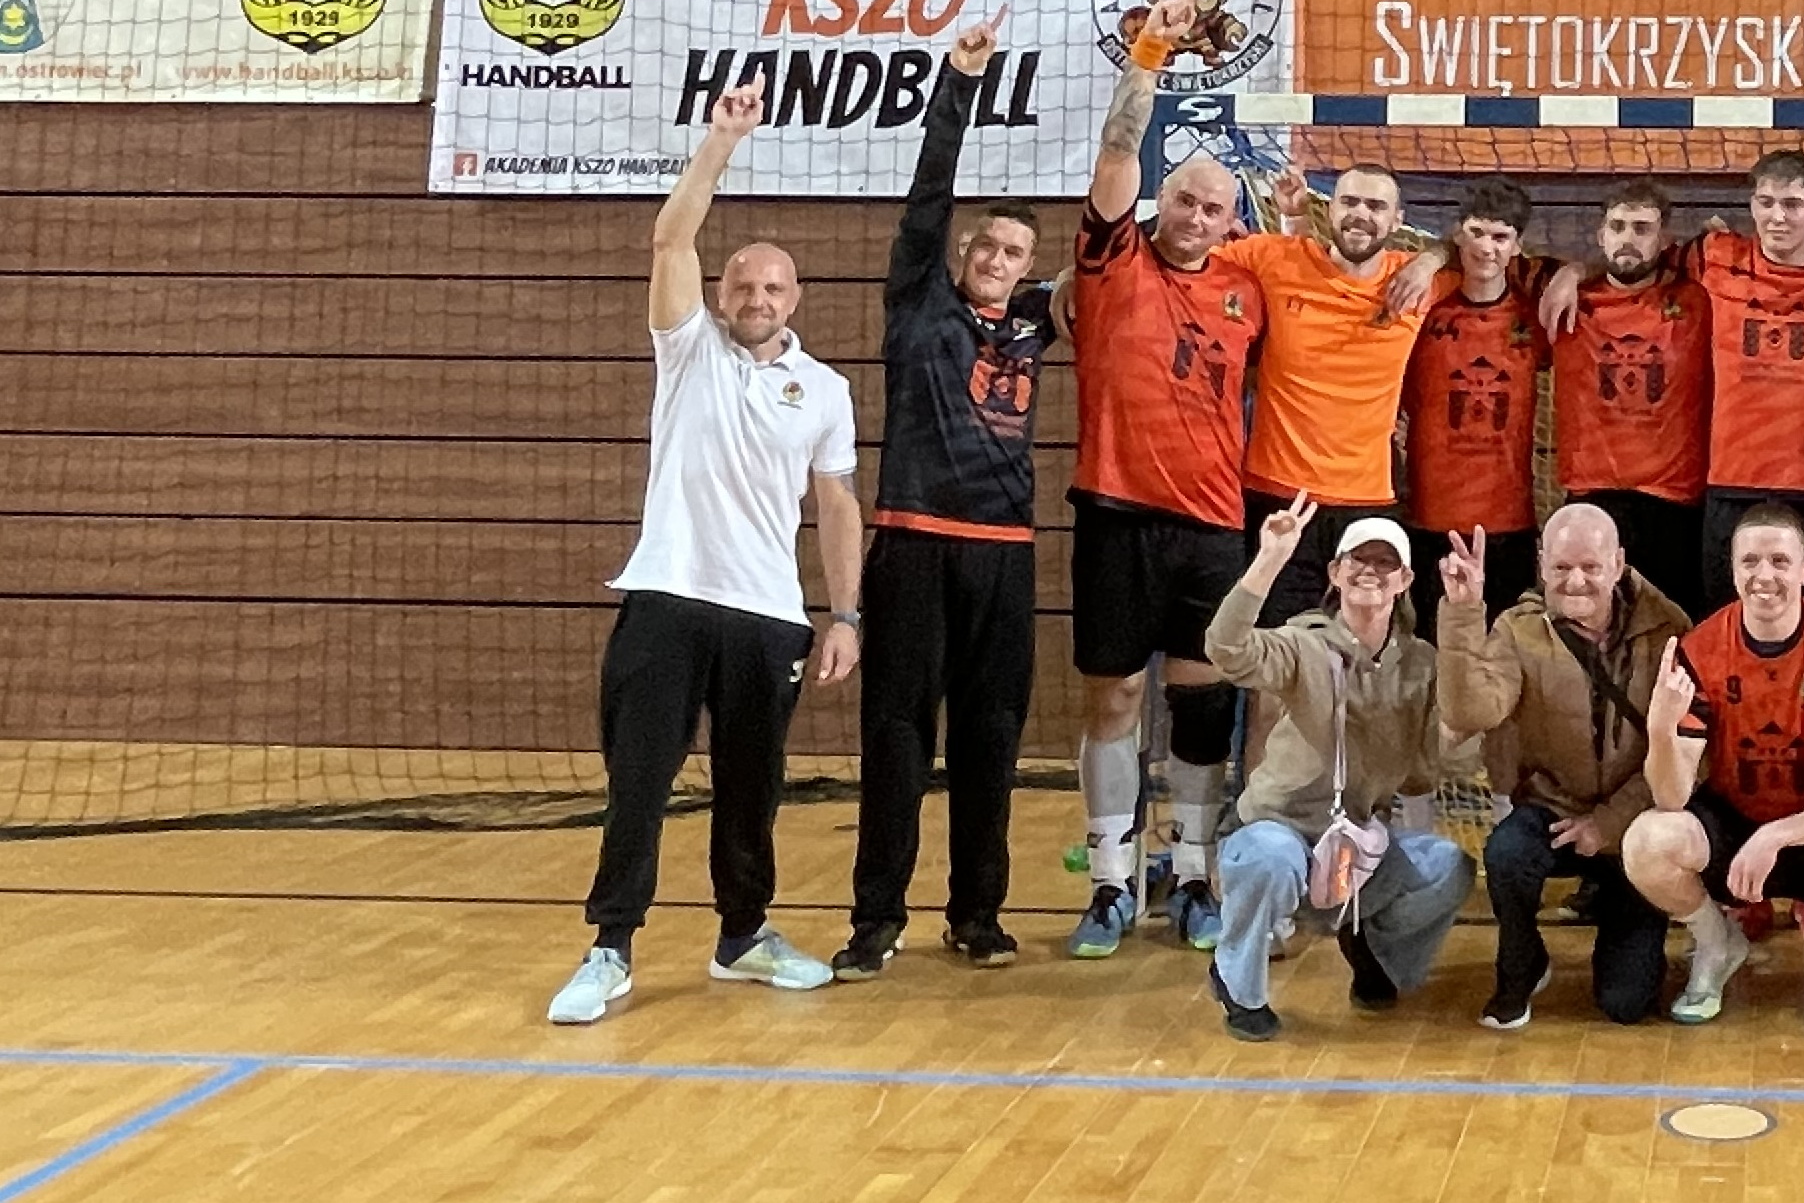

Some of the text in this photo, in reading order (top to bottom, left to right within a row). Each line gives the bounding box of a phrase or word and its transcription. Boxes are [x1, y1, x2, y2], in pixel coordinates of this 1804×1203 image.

[289, 10, 340, 27] 1929
[527, 13, 580, 29] 1929
[461, 63, 632, 89] HANDBALL
[1726, 675, 1742, 705] 9
